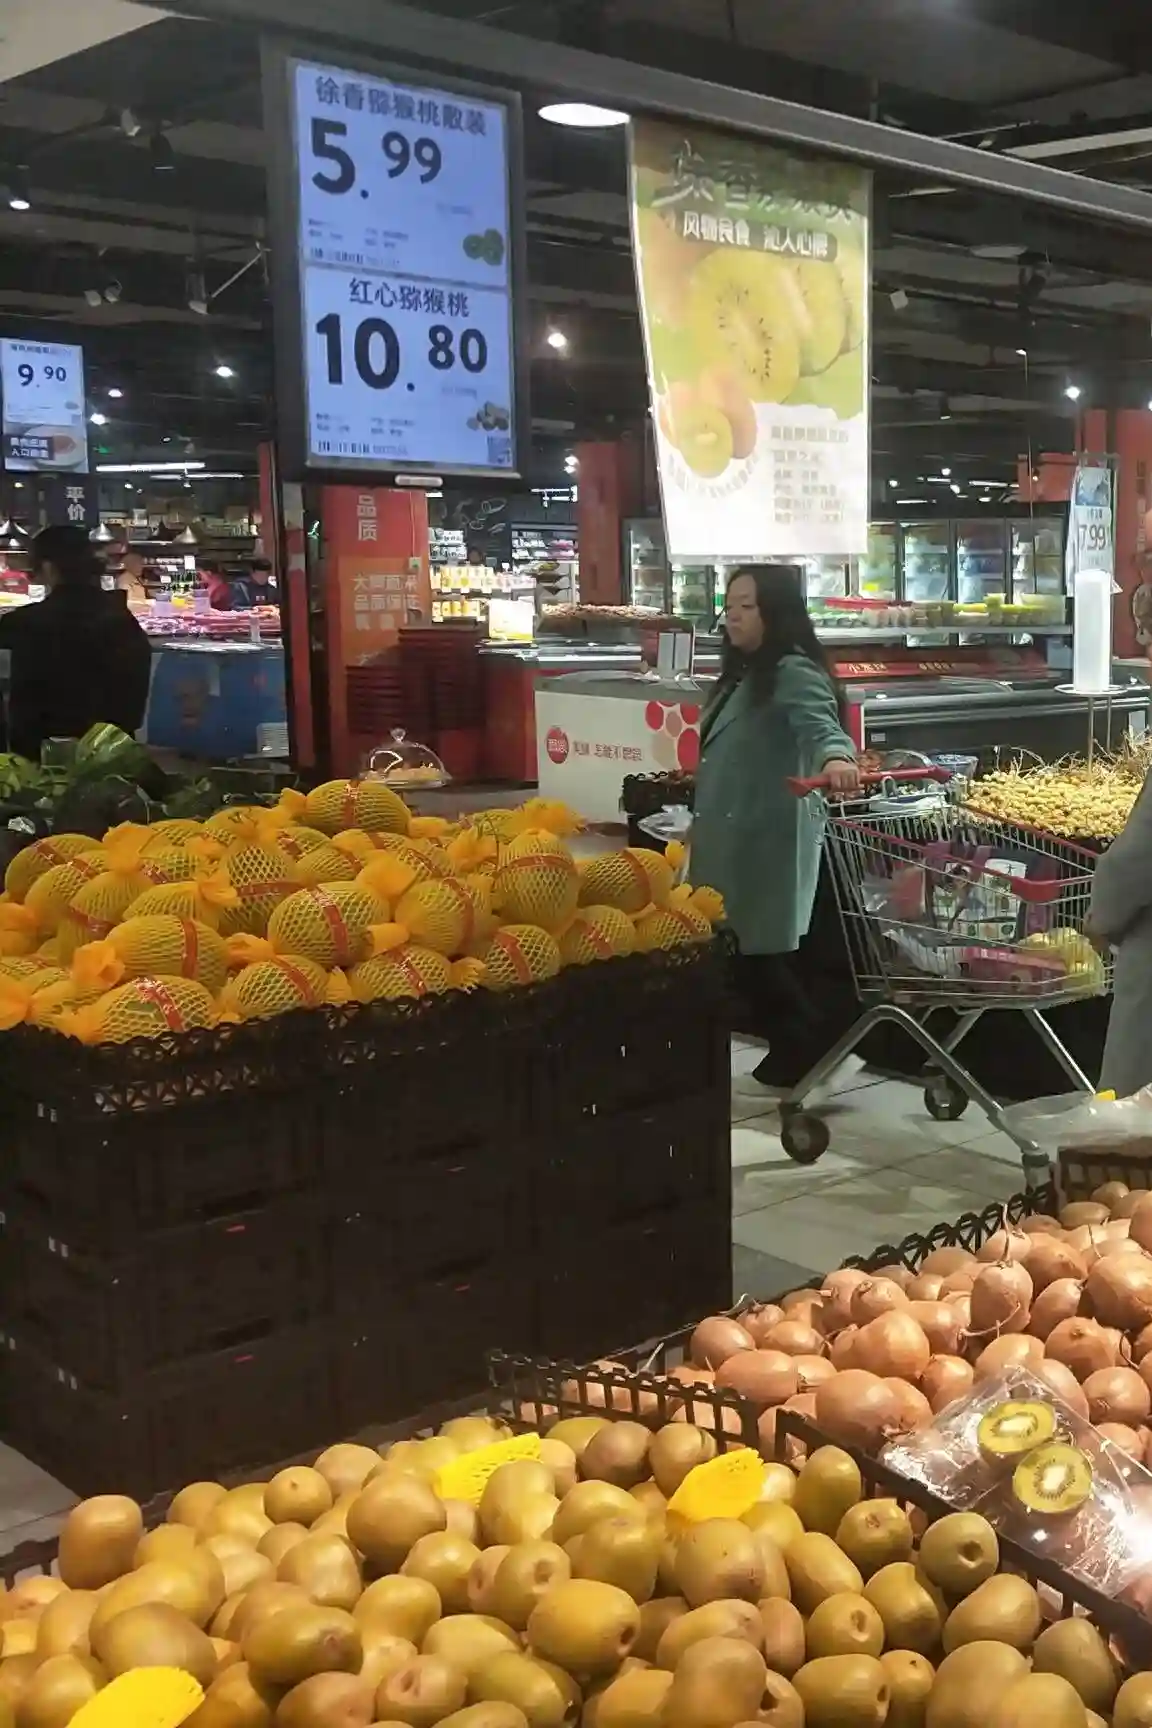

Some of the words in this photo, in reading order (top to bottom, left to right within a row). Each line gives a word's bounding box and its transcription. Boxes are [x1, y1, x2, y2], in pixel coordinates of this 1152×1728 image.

[349, 277, 471, 318] 红心猕猴桃
[316, 313, 488, 391] 10.80
[357, 494, 378, 542] 品质
